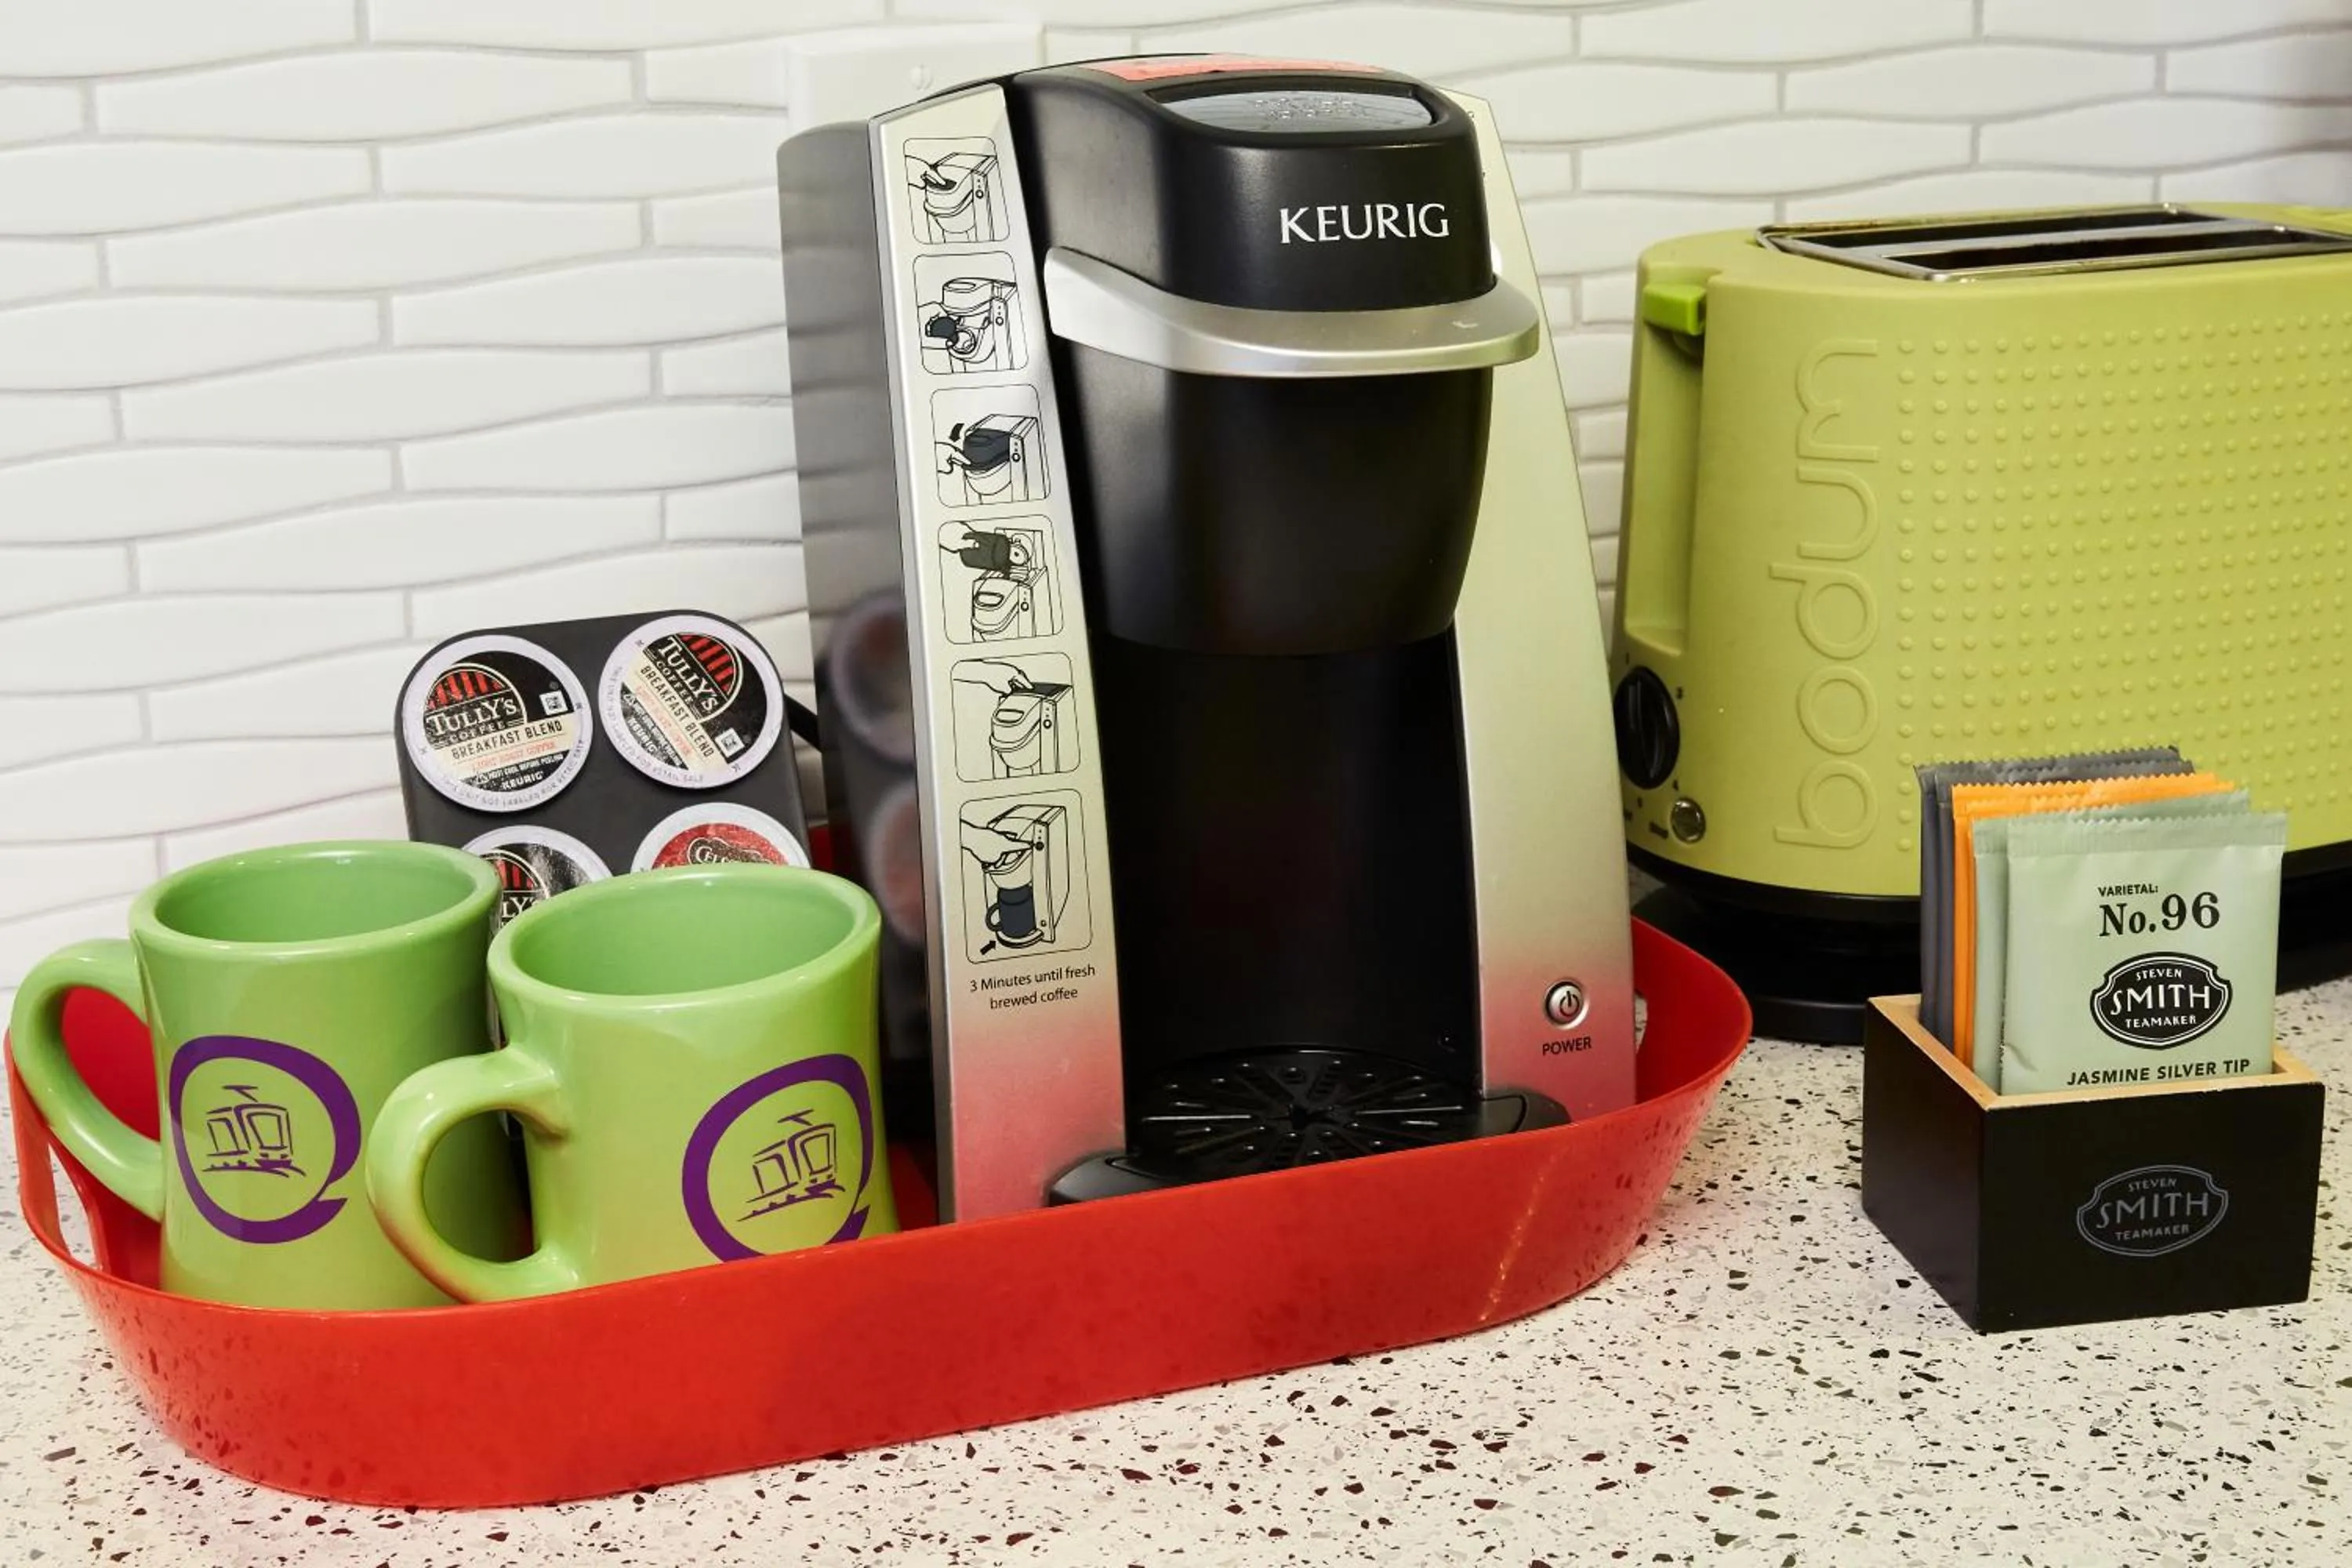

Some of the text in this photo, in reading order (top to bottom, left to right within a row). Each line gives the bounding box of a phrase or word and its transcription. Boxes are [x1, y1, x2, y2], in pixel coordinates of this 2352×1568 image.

[1279, 203, 1450, 243] KEURIG
[1769, 338, 1881, 849] bodum
[656, 661, 694, 705] COFFEE
[659, 636, 718, 712] TULLY'S
[426, 698, 517, 736] TULLY'S
[640, 666, 690, 722] BREAKFAST
[684, 721, 716, 758] BLEND
[450, 720, 506, 742] COFFEE
[450, 719, 563, 759] BREAKFAST BLEND
[502, 771, 544, 790] KEURIG
[2097, 884, 2158, 897] VARIETAL:
[969, 964, 1096, 993] 3 Minutes until fresh
[2136, 968, 2183, 981] STEVEN
[989, 987, 1079, 1010] brewed coffee
[2110, 984, 2210, 1015] SMITH
[2125, 1014, 2196, 1029] TEAMAKER
[1542, 1036, 1592, 1057] POWER
[2067, 1058, 2251, 1086] JASMINE SILVER TIP
[2128, 1178, 2178, 1192] STEVEN
[2096, 1192, 2209, 1229] SMITH
[2114, 1223, 2190, 1241] TEAMAKER
